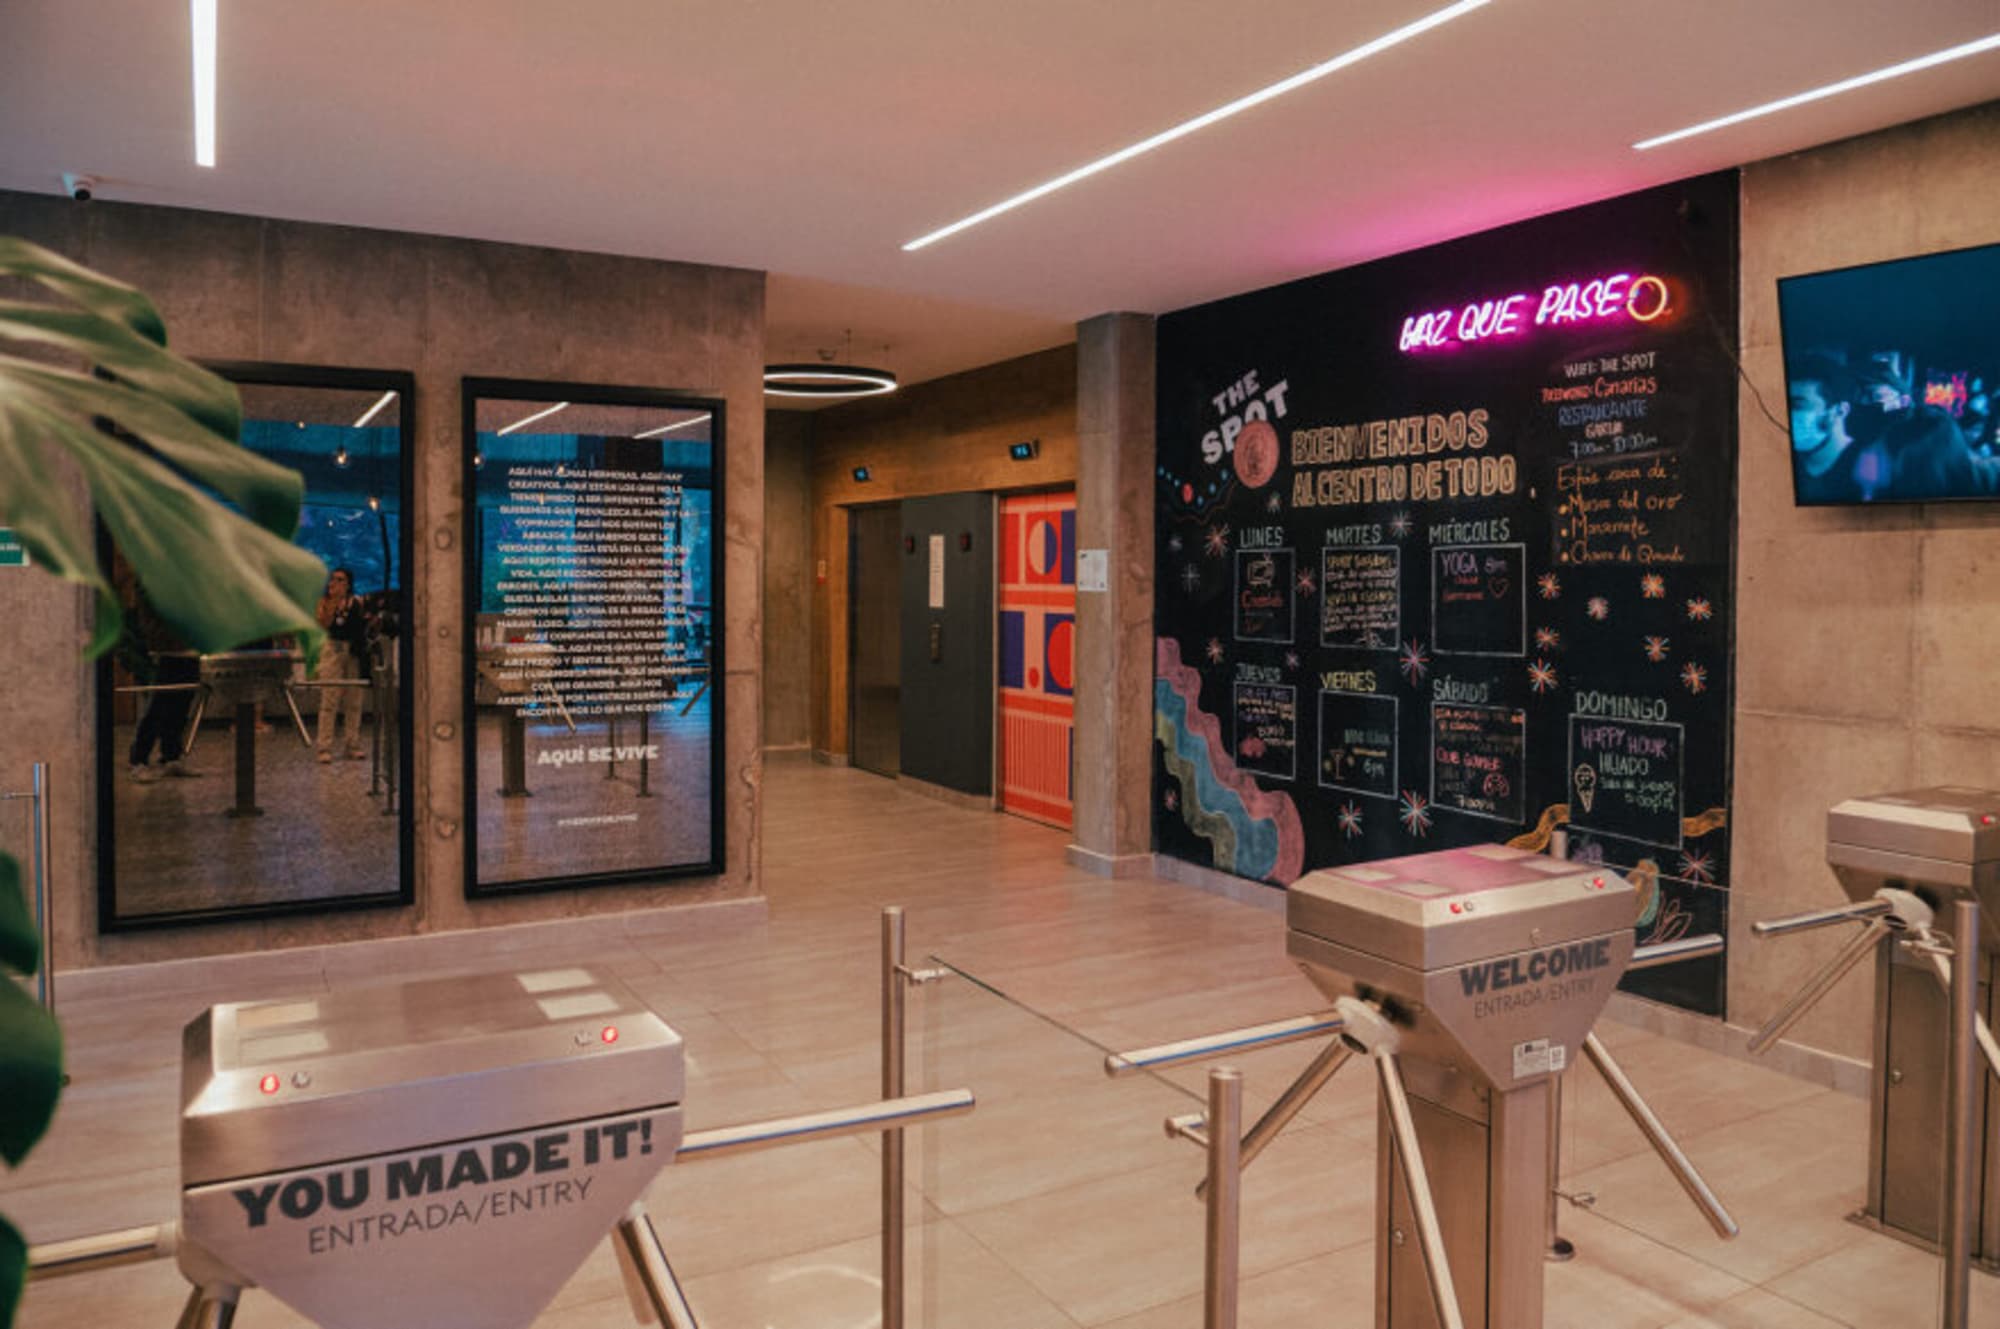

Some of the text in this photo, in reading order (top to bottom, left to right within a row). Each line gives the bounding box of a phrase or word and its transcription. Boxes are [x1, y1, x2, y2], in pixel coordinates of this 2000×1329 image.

[1399, 310, 1453, 351] HAZ
[1458, 294, 1526, 341] QUE
[1600, 358, 1618, 372] THE
[1622, 352, 1656, 371] SPOT
[1213, 368, 1260, 416] THE
[1201, 378, 1289, 465] SPOT
[1291, 408, 1489, 465] BIENVENIDOS
[1292, 454, 1517, 508] AL CENTRO DE TODO
[1240, 526, 1284, 547] LUNES
[1326, 524, 1382, 545] MARTES
[1429, 516, 1510, 544] MIÉRCOLES
[1441, 551, 1478, 577] YOGA
[1235, 663, 1281, 682] JUEVES
[1320, 671, 1376, 692] VIERNES
[1433, 674, 1489, 702] SÁBADO
[1576, 690, 1668, 721] DOMINGO
[538, 745, 659, 768] AQUÍ SE VIVE
[1581, 725, 1668, 758] HAPPY HOUR
[1459, 938, 1612, 997] WELCOME
[1474, 975, 1595, 1020] ENTRADA/ENTRY
[233, 1117, 655, 1229] YOU MADE IT!
[308, 1175, 594, 1256] ENTRADA/ENTRY
